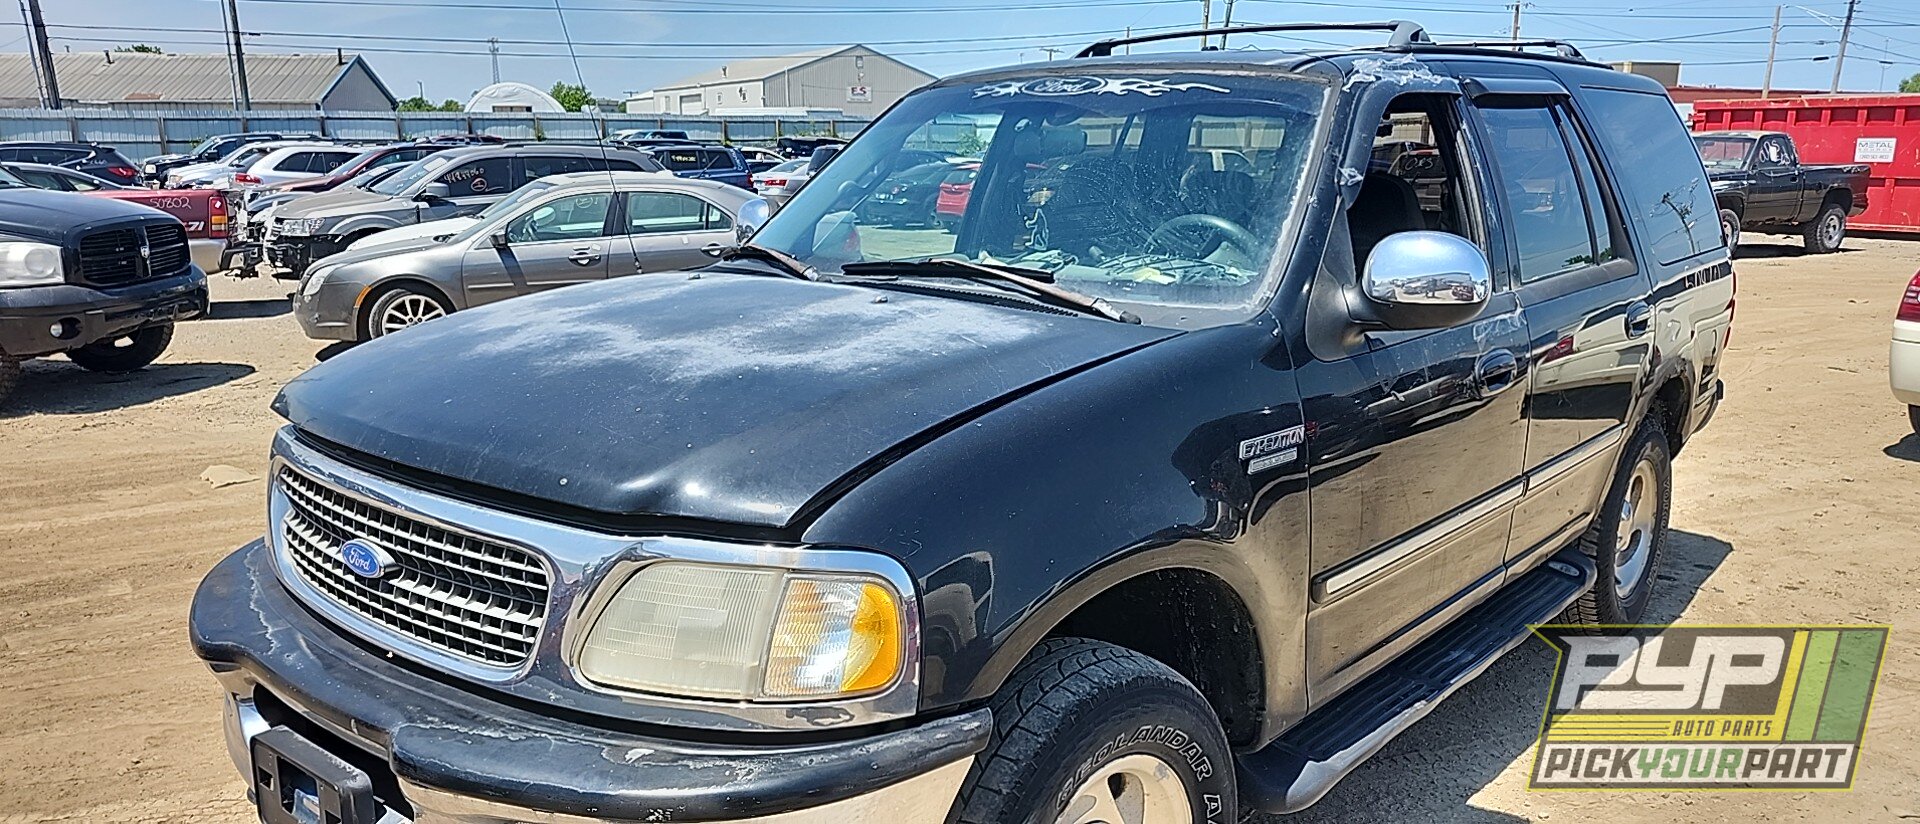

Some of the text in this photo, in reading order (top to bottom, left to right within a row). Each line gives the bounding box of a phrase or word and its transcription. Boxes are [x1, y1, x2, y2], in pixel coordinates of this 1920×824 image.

[1034, 78, 1090, 92] Ford
[349, 547, 371, 571] Ford
[1056, 725, 1213, 810] GEOLANDAR
